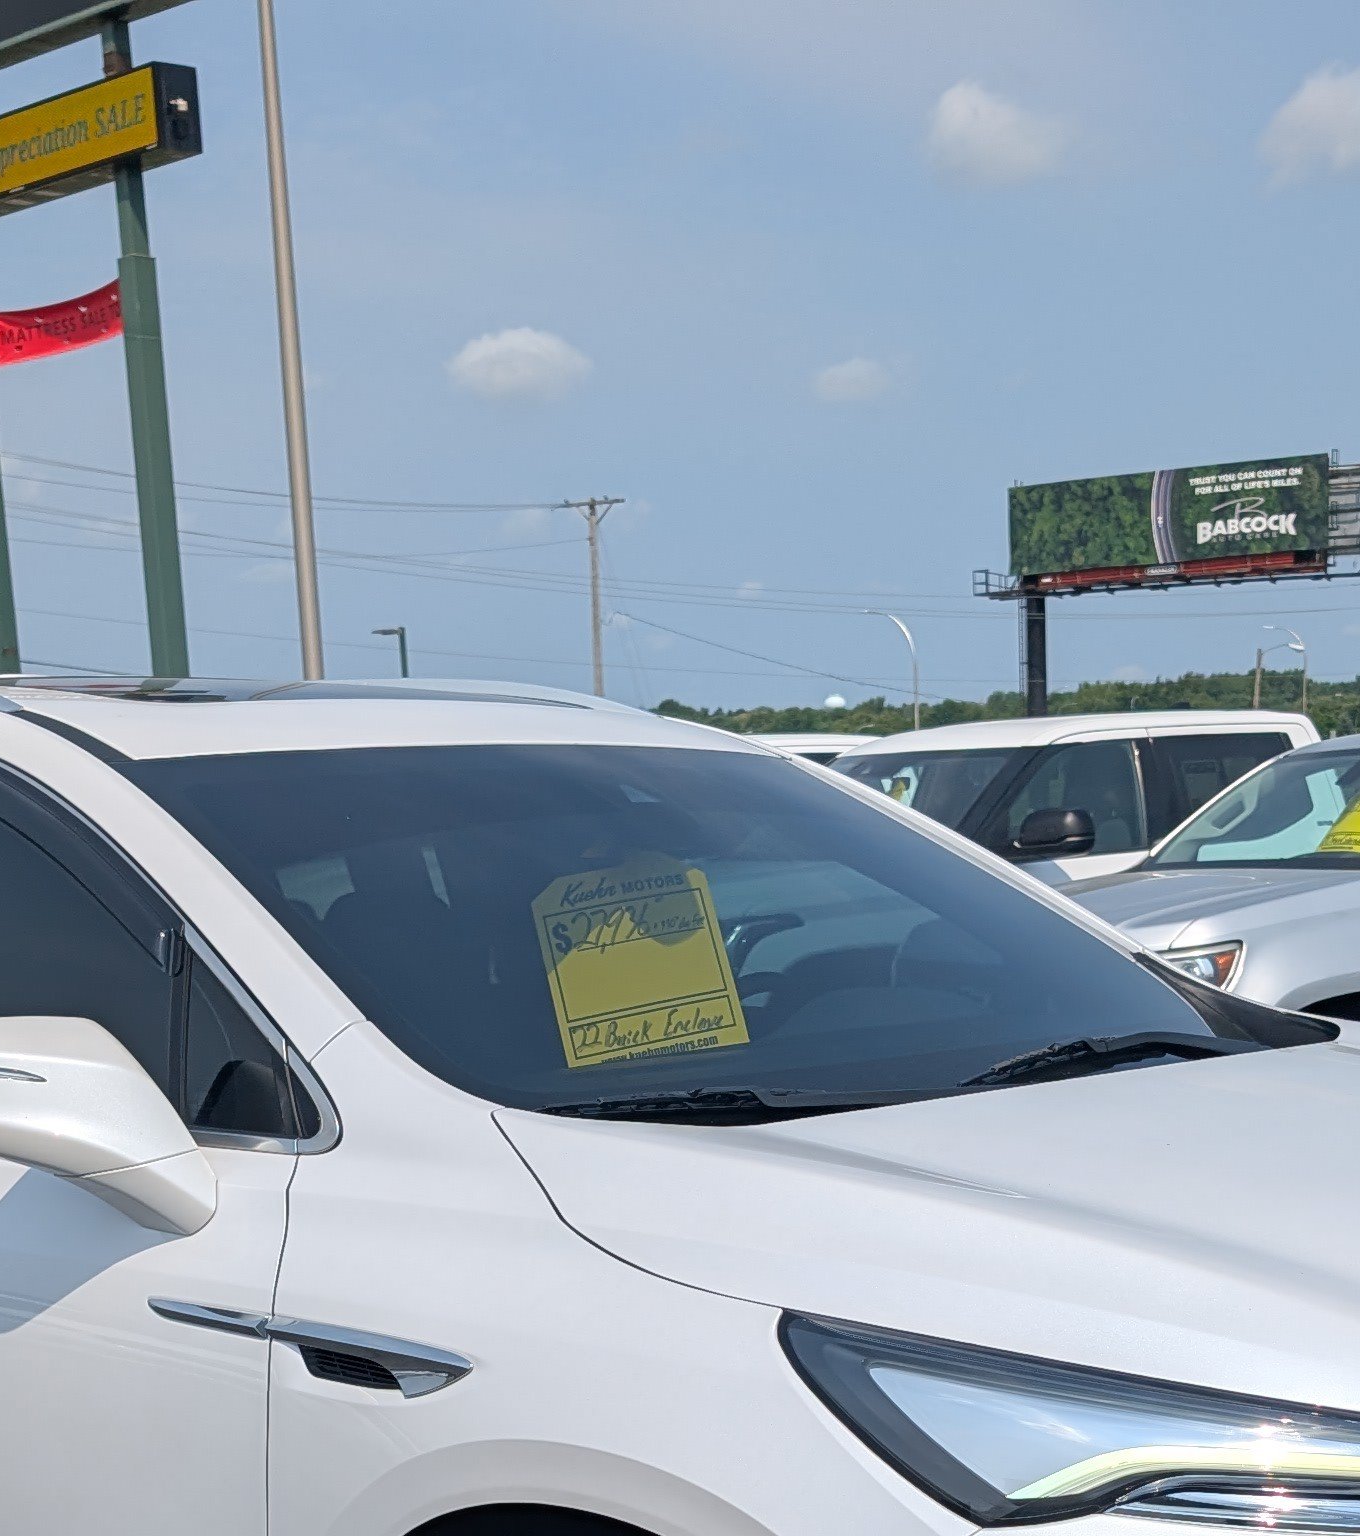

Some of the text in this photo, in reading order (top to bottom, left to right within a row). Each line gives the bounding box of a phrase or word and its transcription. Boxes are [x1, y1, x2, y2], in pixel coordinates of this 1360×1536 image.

[94, 93, 146, 138] SALE
[0, 318, 76, 345] MATTRESS
[81, 308, 106, 329] SALE
[1189, 467, 1303, 486] TRUST YOU CAN COUNT ON
[1195, 486, 1213, 495] FOR
[1214, 484, 1230, 493] ALL
[1231, 482, 1242, 491] OF
[1197, 513, 1297, 544] BABCOCK
[621, 873, 684, 894] MOTORS
[572, 1008, 723, 1052] 22 Buick Enclave
